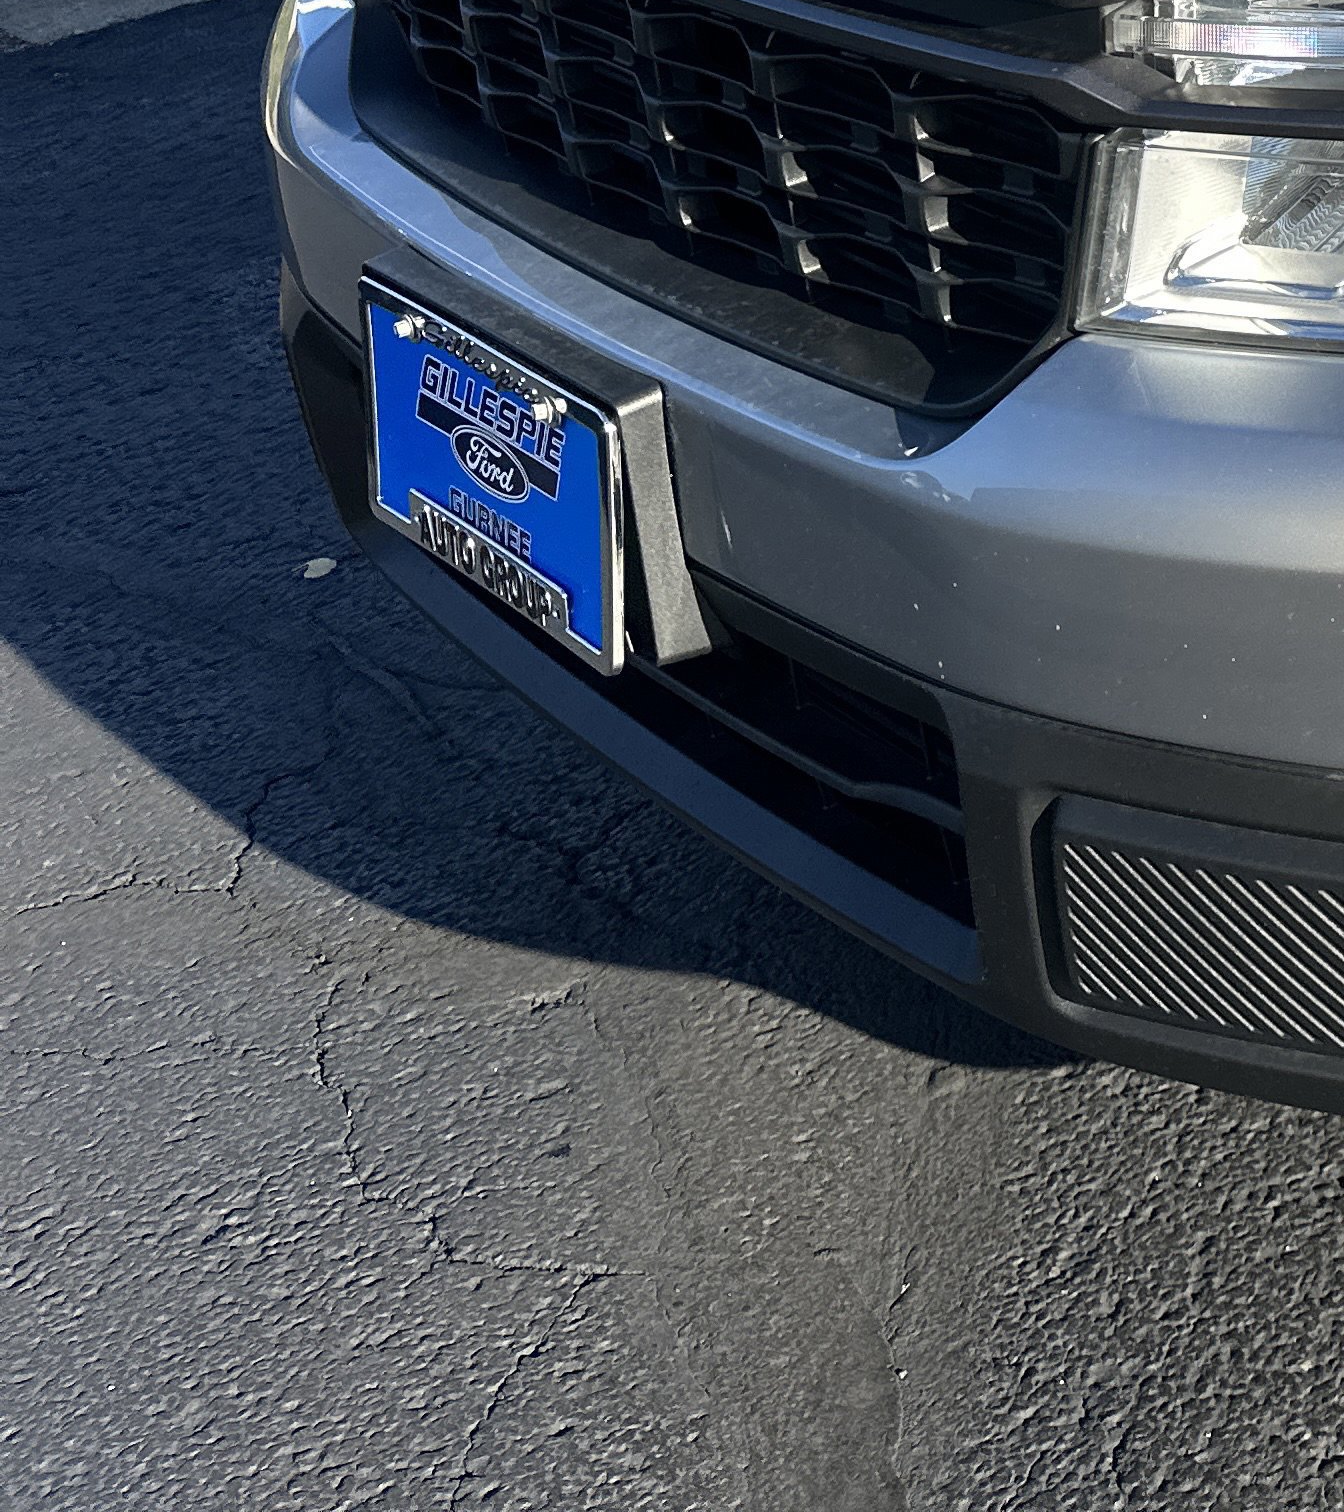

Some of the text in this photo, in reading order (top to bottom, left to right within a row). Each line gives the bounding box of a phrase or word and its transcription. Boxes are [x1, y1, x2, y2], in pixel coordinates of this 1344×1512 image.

[419, 353, 567, 470] GILLESPIE
[465, 436, 515, 494] Ford
[419, 502, 552, 627] AUTO GROUP
[448, 484, 532, 564] GURNEE
